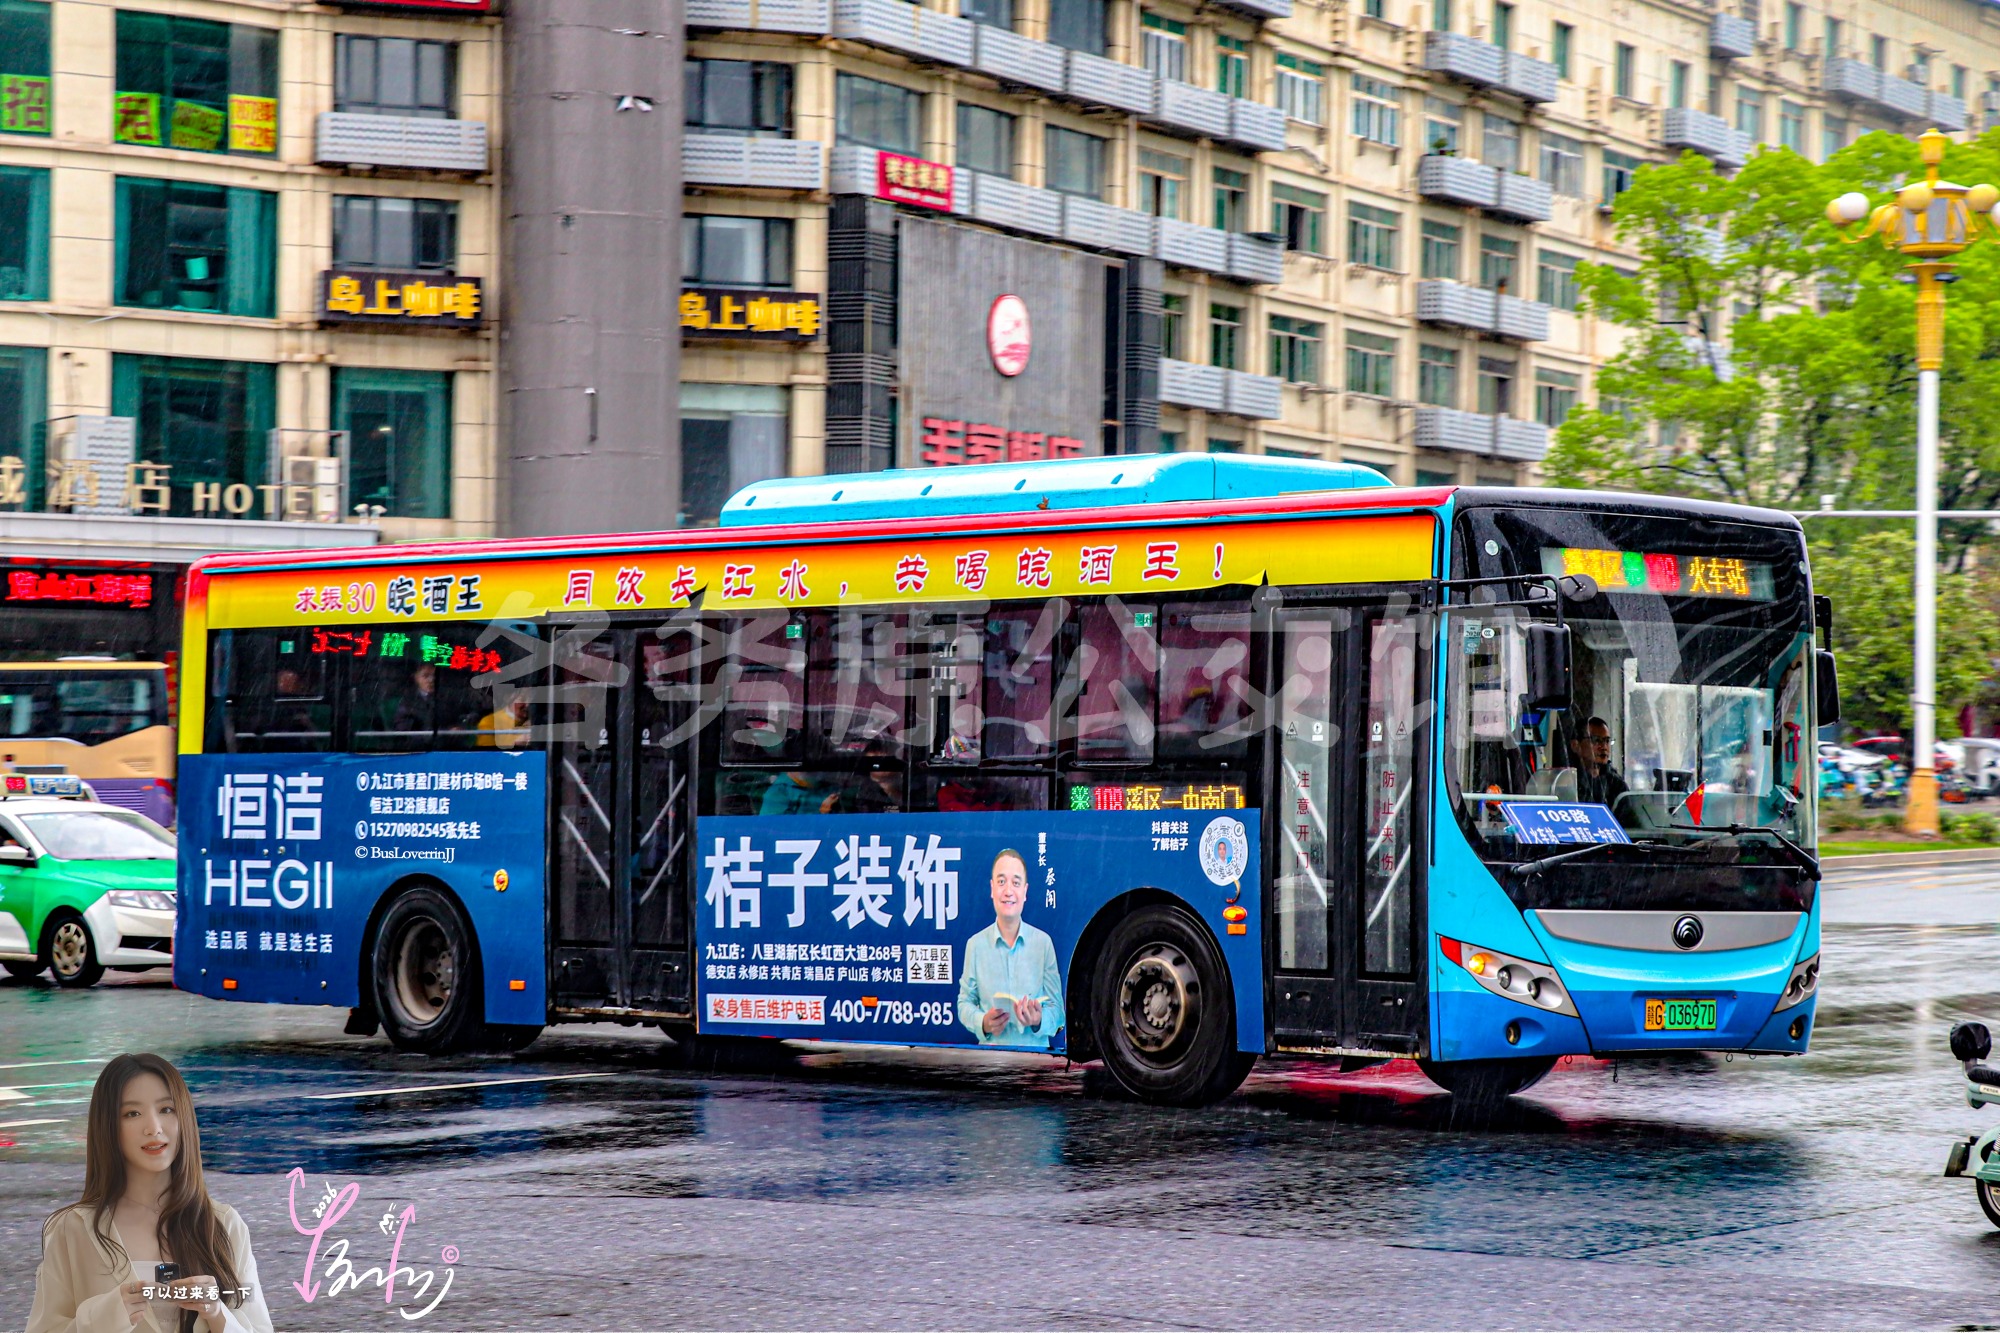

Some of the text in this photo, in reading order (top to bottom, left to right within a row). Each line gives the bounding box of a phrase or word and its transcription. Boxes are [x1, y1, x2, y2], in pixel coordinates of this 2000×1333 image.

[1689, 556, 1750, 595] 火车站
[387, 574, 483, 616] 皖酒王
[217, 772, 325, 840] 恒洁
[369, 797, 450, 815] 恒洁卫浴旗舰店
[1536, 808, 1591, 824] 108路
[1151, 820, 1189, 835] 抖音关注
[1381, 770, 1396, 871] 防止夹伤
[1151, 838, 1189, 851] 了解桔子
[204, 859, 333, 909] HEGII
[704, 834, 962, 929] 桔子装饰
[205, 931, 333, 954] 选品质 就是选生活
[909, 947, 950, 961] 九江县区
[705, 965, 903, 983] 德安店 永修店 共青店 瑞昌店 庐山店 修水店
[910, 962, 950, 981] 全覆盖
[712, 997, 822, 1021] 终身售后维护电话
[830, 999, 954, 1026] 400-7788-985
